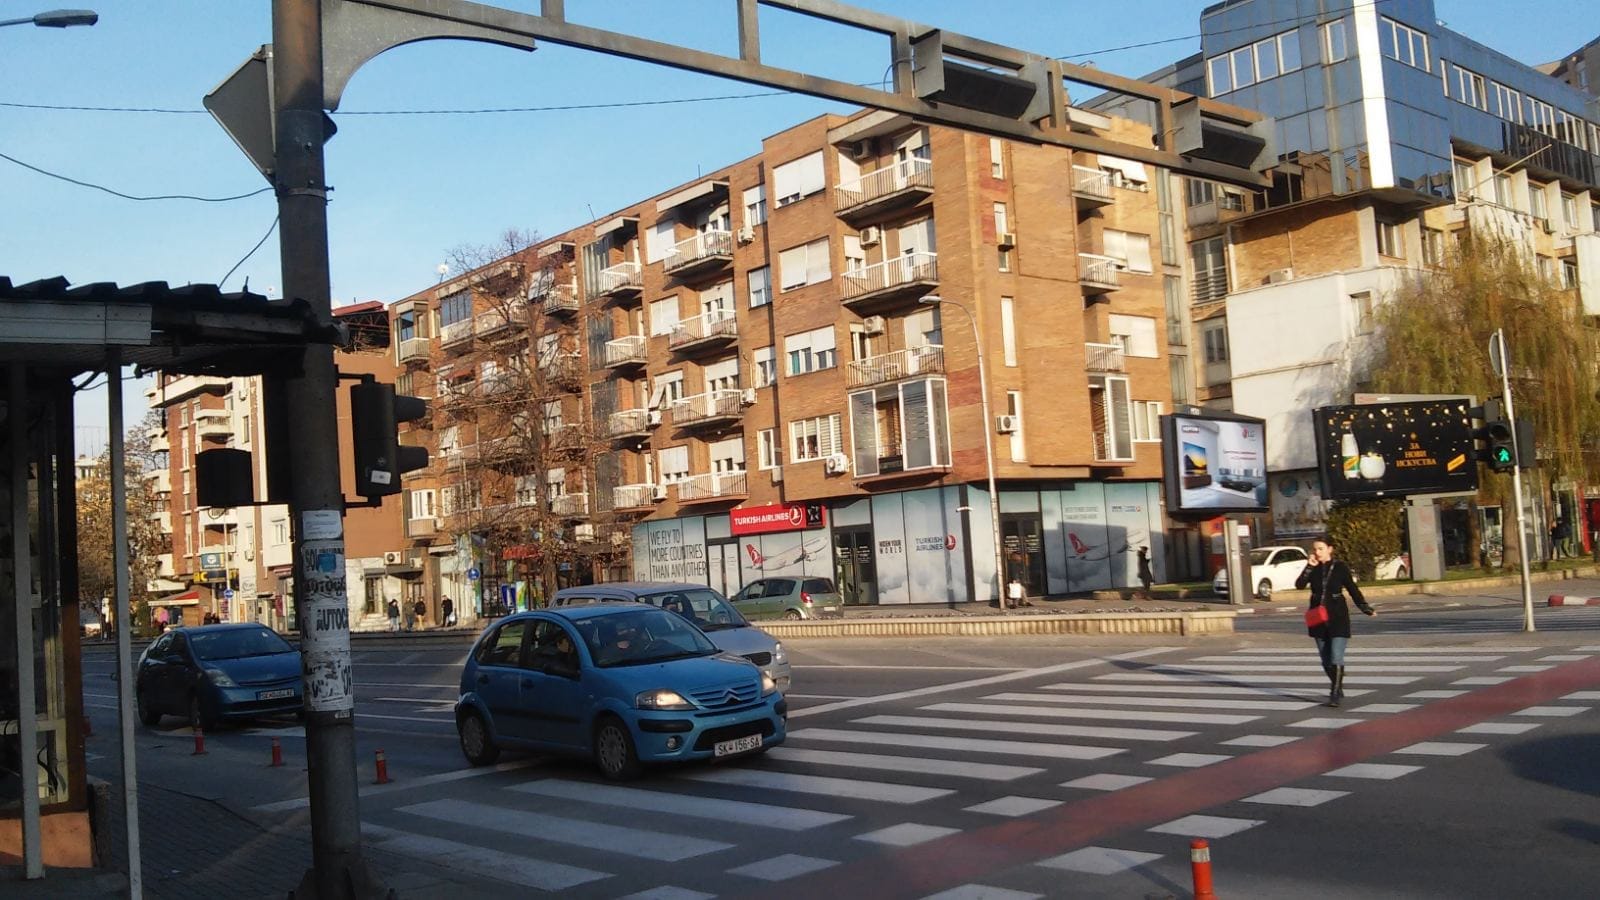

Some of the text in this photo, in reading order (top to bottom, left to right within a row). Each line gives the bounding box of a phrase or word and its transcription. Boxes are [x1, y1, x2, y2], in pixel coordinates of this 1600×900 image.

[734, 512, 790, 526] TURKISH AIRLINES
[650, 528, 681, 546] WE FLY TO
[915, 536, 943, 545] TURKISH
[650, 543, 704, 563] MORE COUNTRIES
[916, 543, 944, 552] AIRLINES
[651, 560, 707, 579] THAN ANY OTHER
